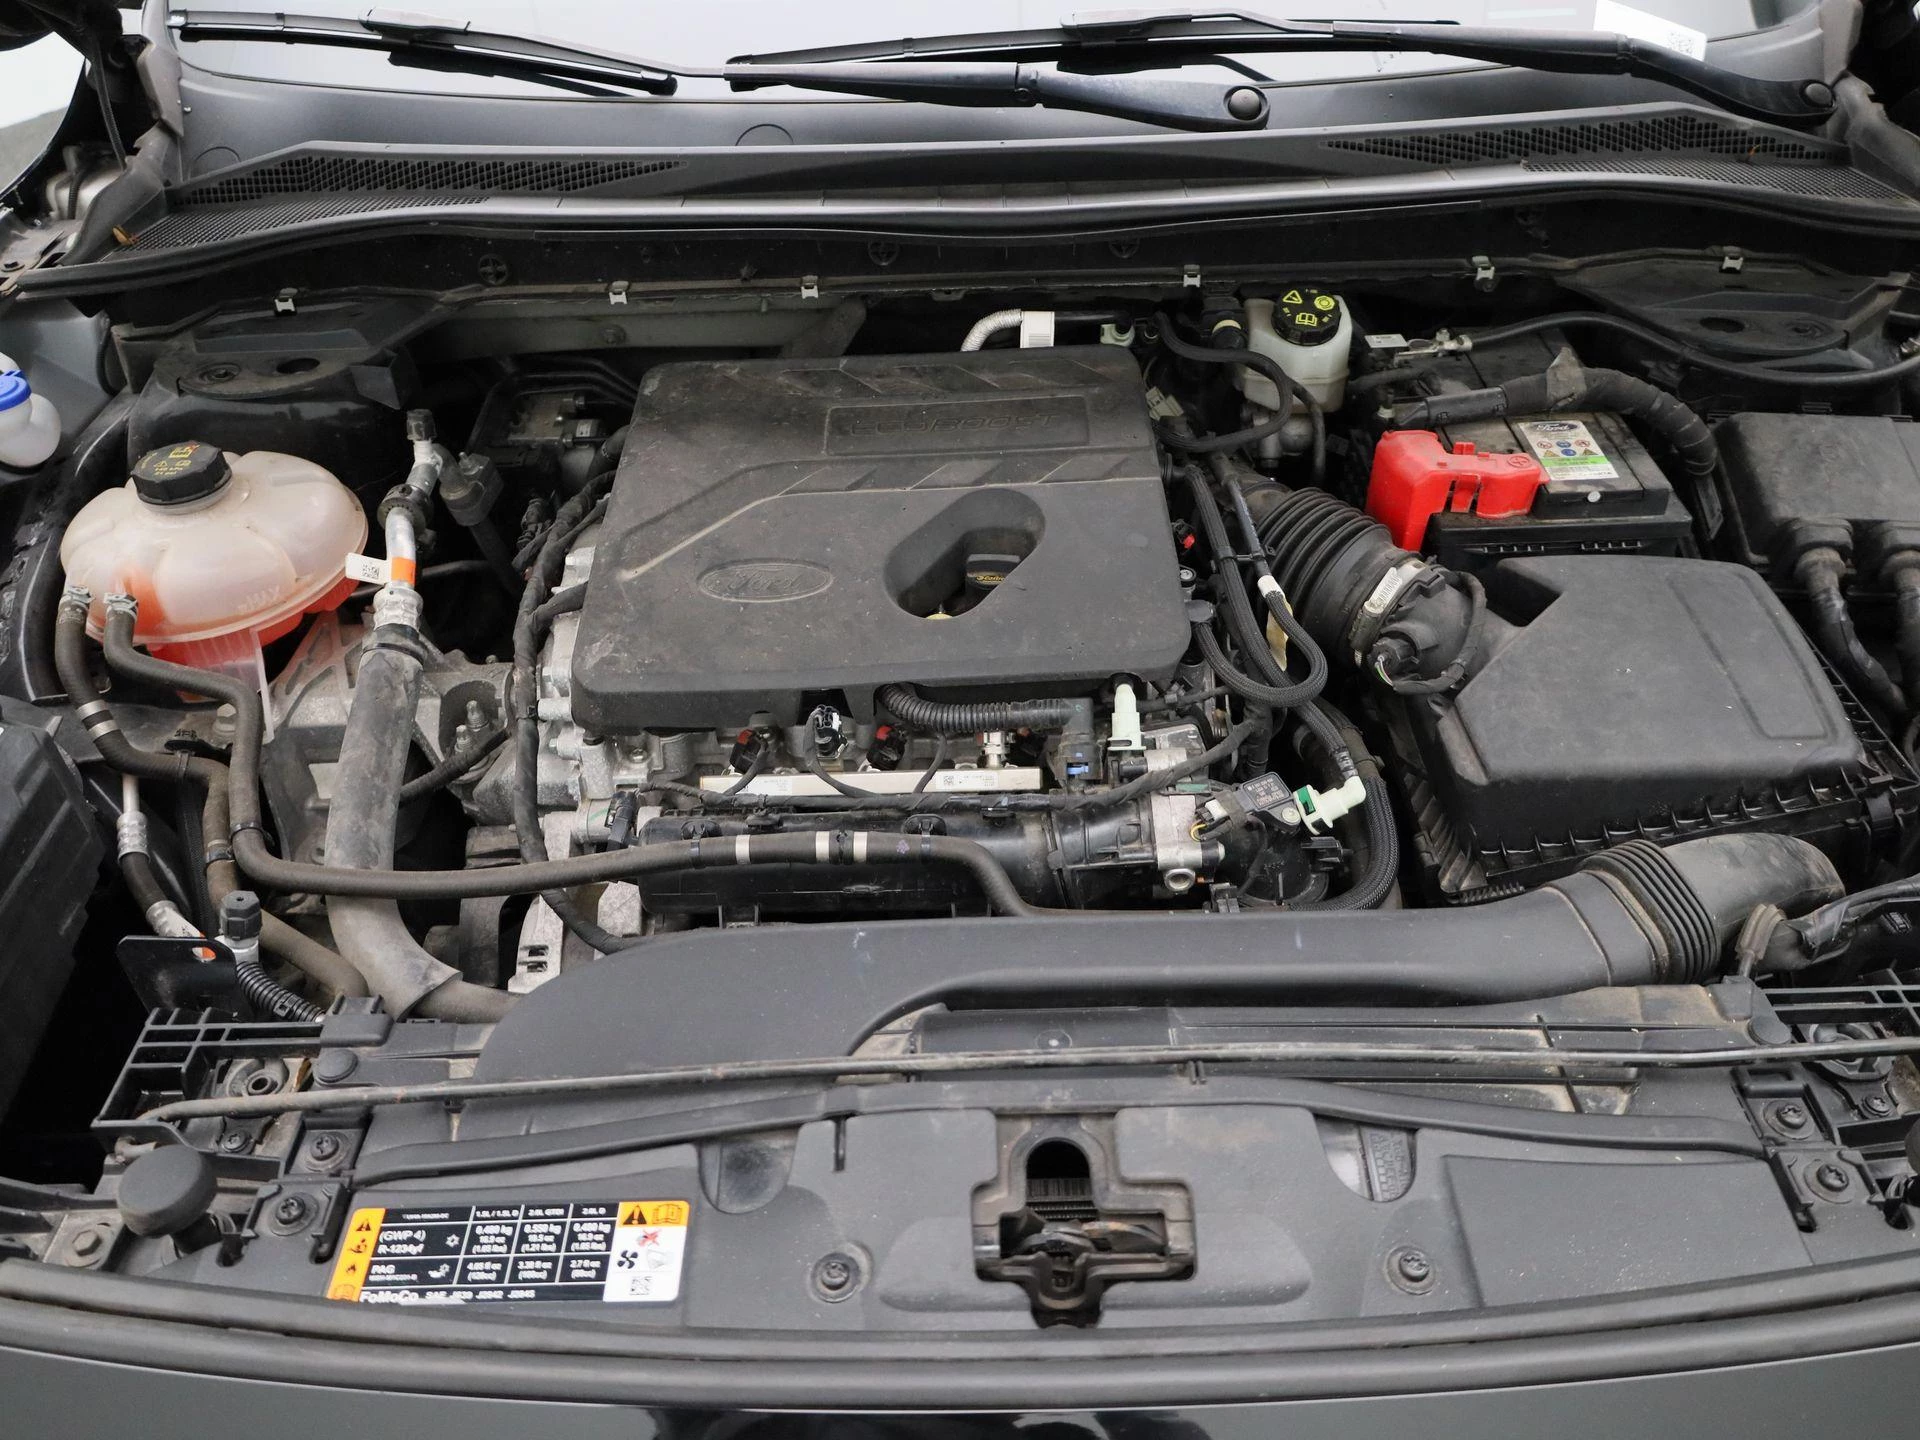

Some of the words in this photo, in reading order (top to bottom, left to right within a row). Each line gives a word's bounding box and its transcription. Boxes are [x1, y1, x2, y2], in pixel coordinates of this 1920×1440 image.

[1536, 422, 1570, 433] Ford
[727, 566, 803, 592] Ford
[370, 1264, 396, 1275] PAG
